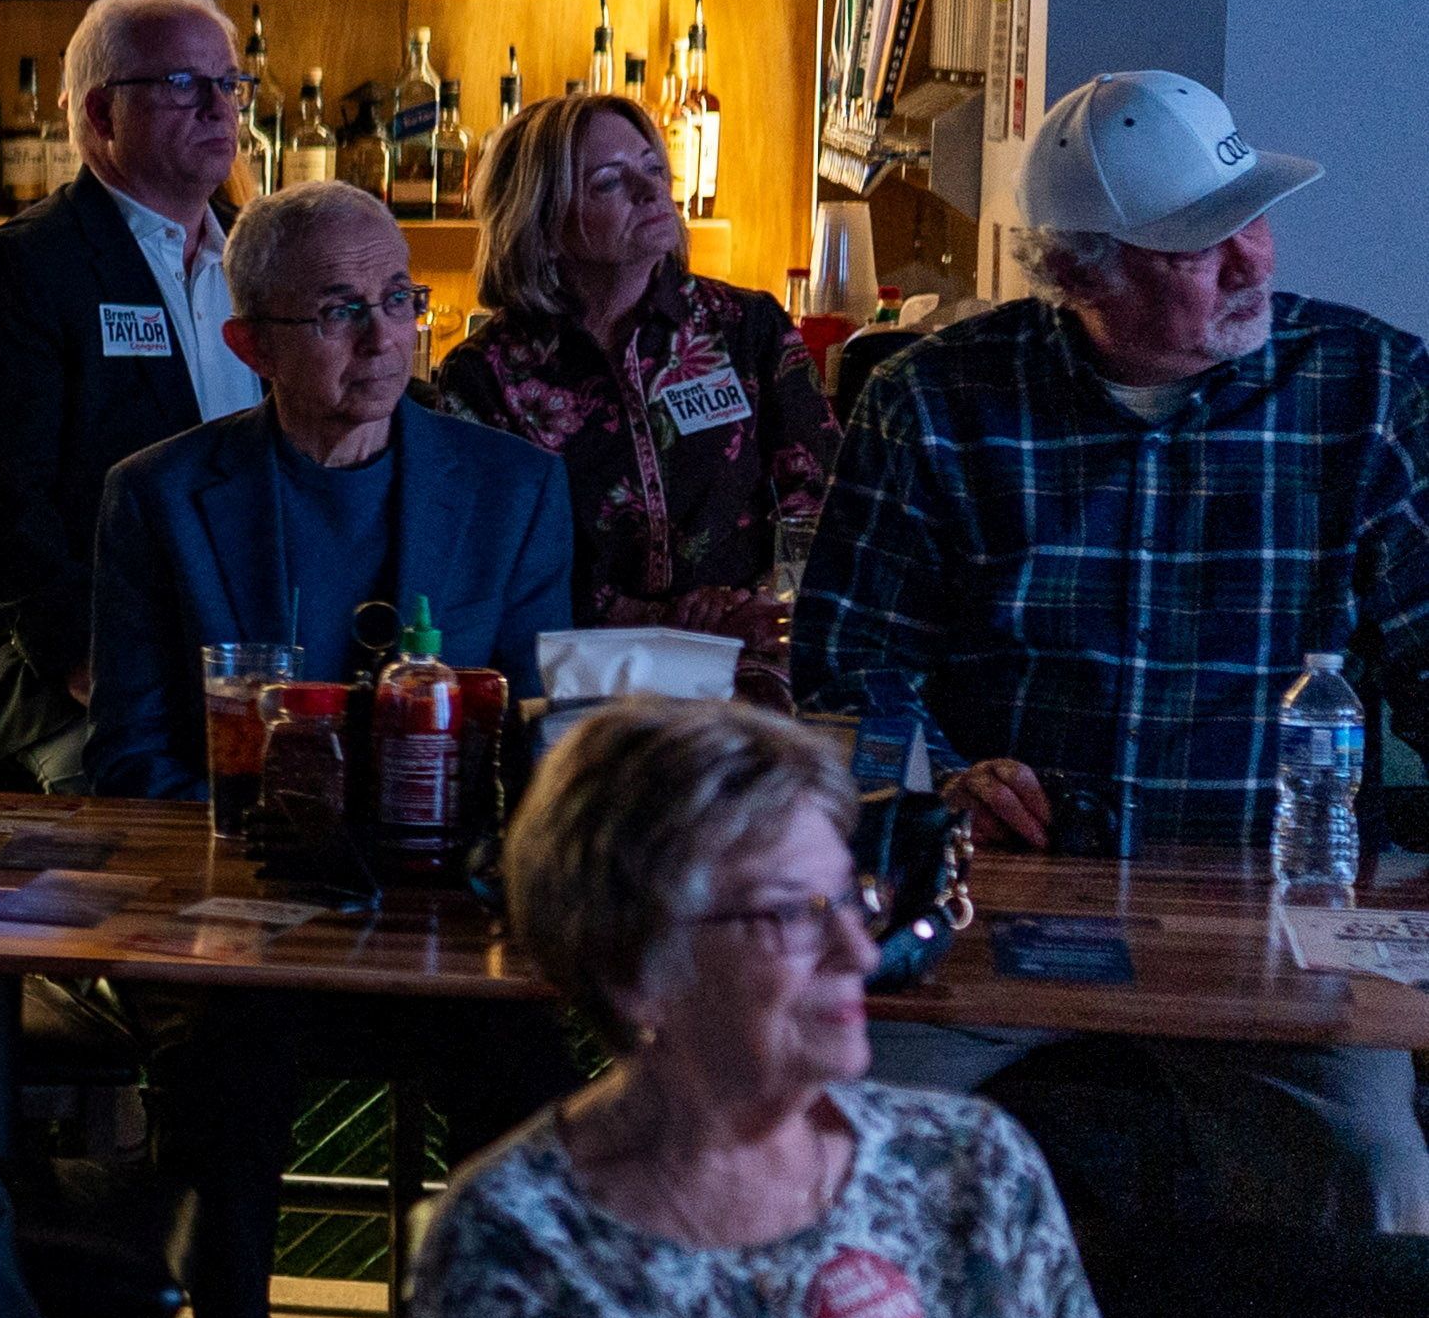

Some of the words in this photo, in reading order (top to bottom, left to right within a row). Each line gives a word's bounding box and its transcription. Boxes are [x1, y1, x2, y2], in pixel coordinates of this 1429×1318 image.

[886, 45, 903, 94] MOON
[103, 308, 137, 321] Brent
[105, 321, 165, 342] TAYLOR
[666, 383, 706, 402] Brent
[672, 385, 743, 420] TAYLOR
